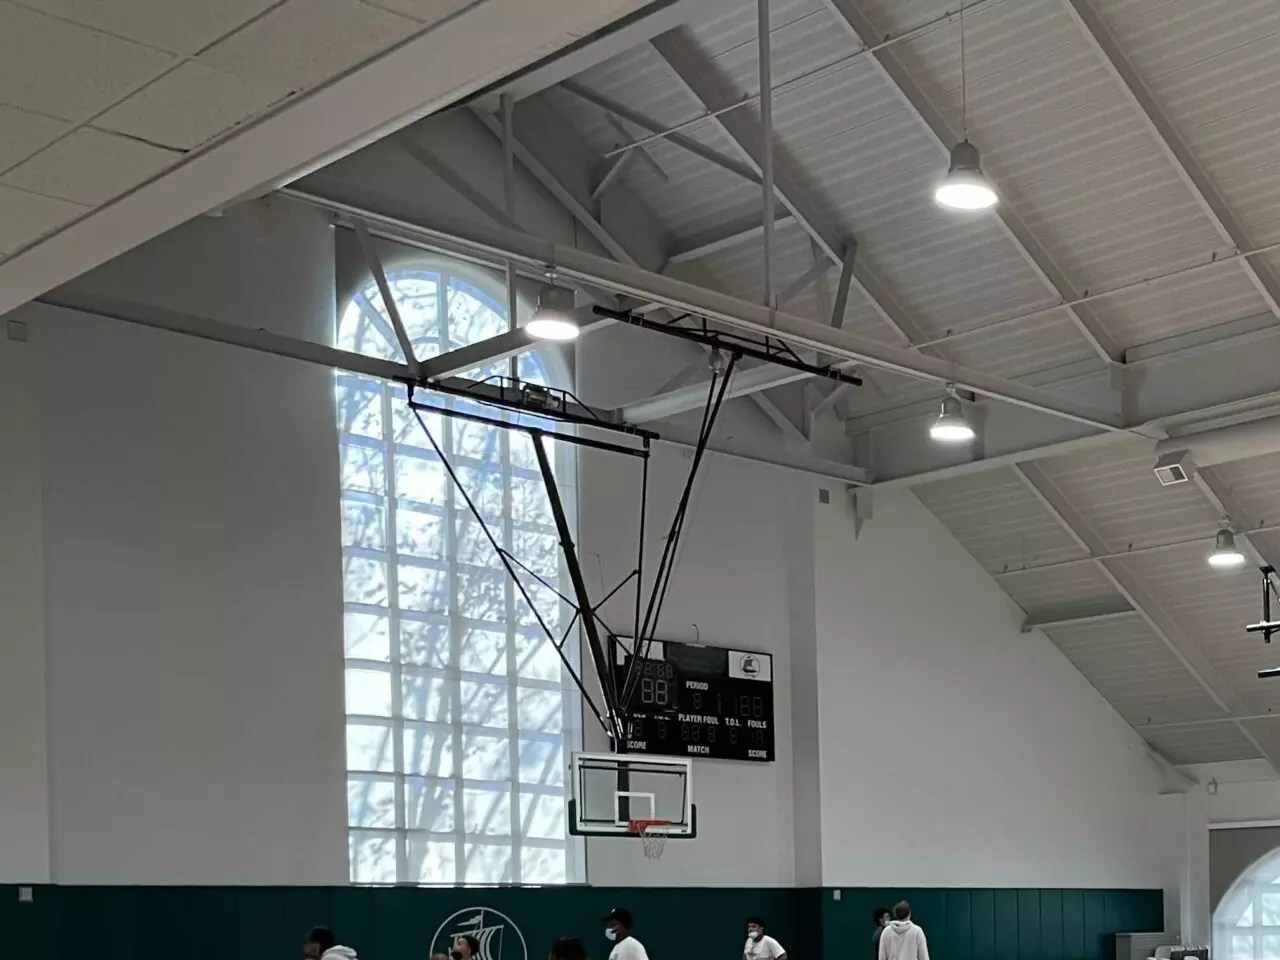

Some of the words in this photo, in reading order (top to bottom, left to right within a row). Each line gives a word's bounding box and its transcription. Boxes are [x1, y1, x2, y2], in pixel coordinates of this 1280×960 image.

[685, 680, 709, 691] PERIOD
[678, 713, 702, 723] PLAYER
[703, 715, 719, 725] FOUL
[747, 719, 767, 729] FOULS
[687, 745, 710, 754] MATCH
[748, 749, 767, 759] SCORE
